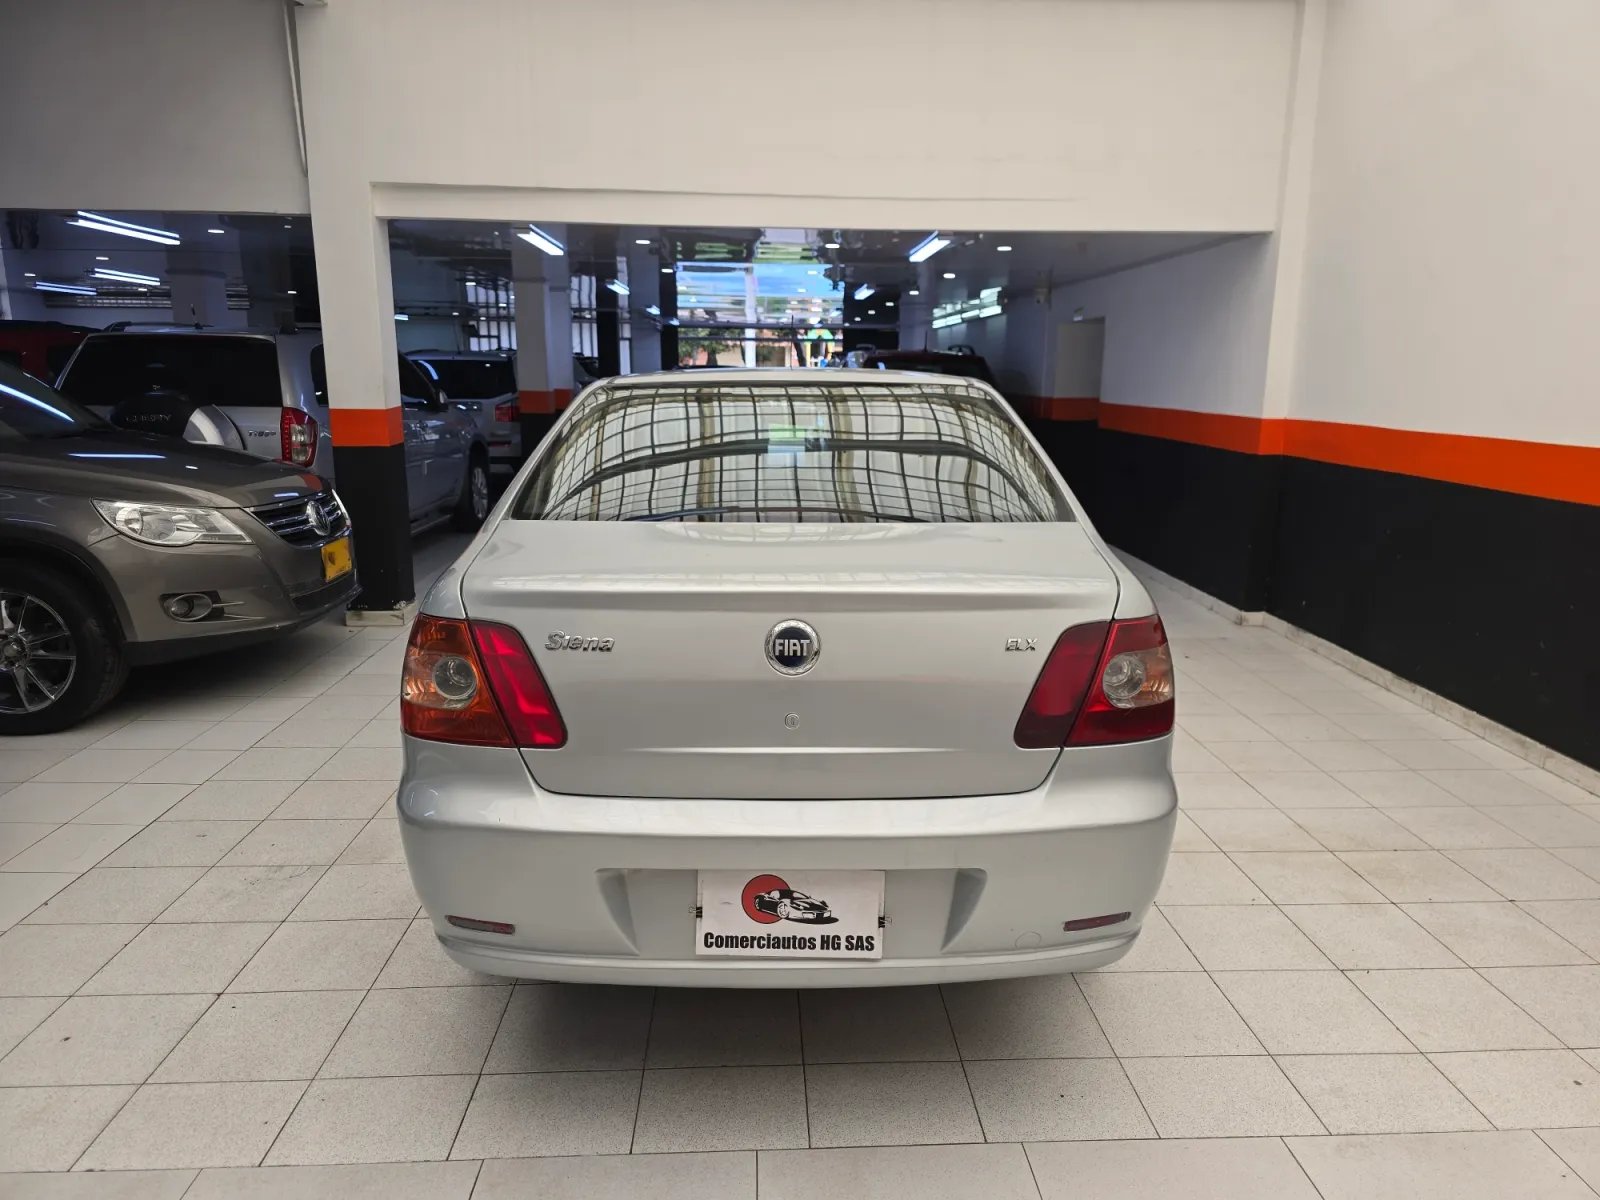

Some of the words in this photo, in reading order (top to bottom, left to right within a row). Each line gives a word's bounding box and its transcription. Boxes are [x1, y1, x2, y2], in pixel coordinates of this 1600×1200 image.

[544, 629, 615, 652] Siena
[774, 638, 811, 657] FIAT
[1005, 637, 1038, 652] ELX
[703, 931, 817, 951] Comerciautos
[819, 934, 842, 951] HG
[844, 935, 876, 952] SAS
